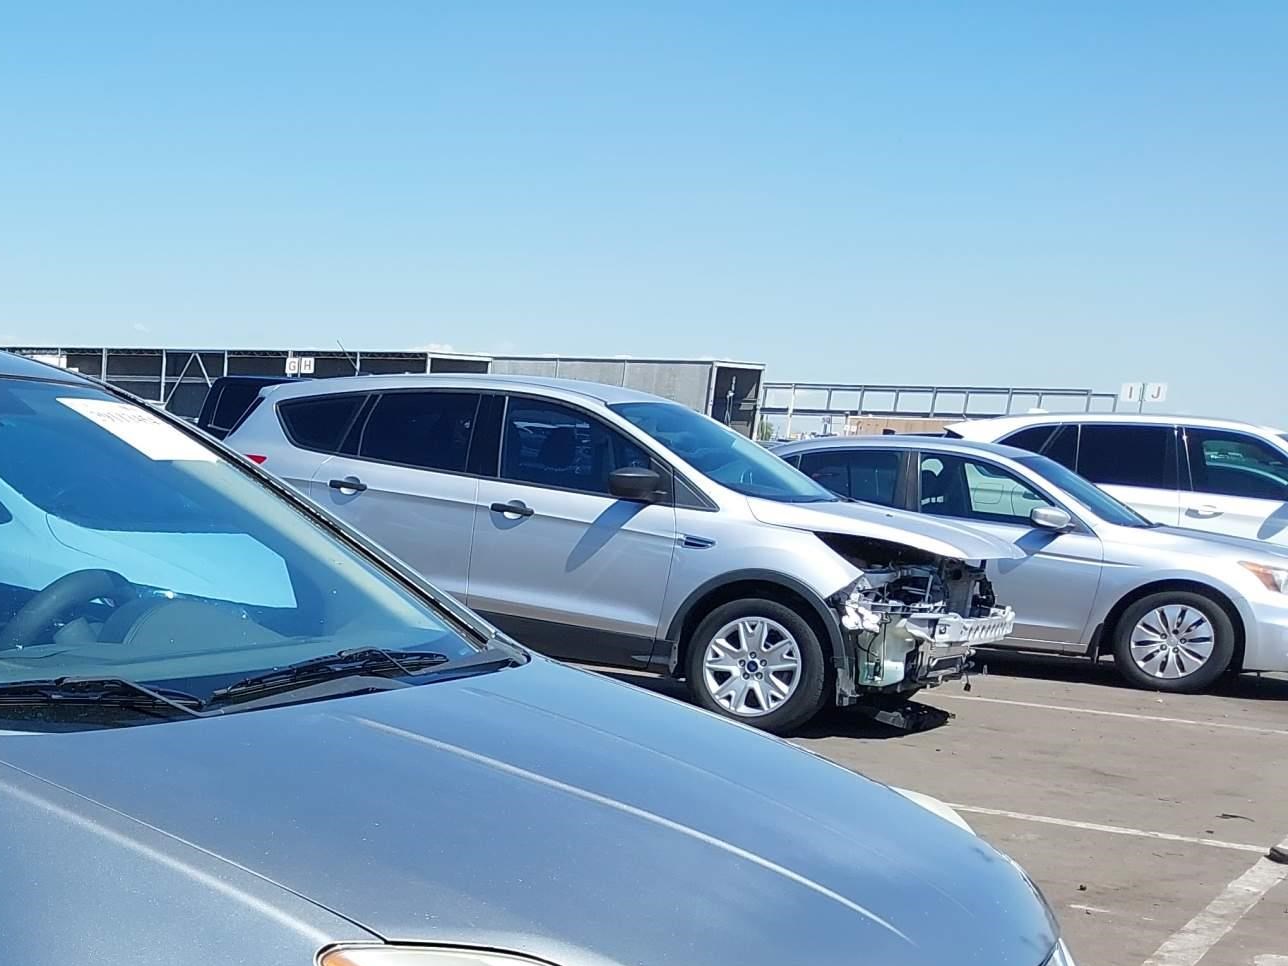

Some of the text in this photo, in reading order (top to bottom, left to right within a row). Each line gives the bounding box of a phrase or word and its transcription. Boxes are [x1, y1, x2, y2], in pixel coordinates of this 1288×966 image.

[288, 360, 297, 371] G
[303, 359, 312, 371] H
[1151, 386, 1161, 399] J
